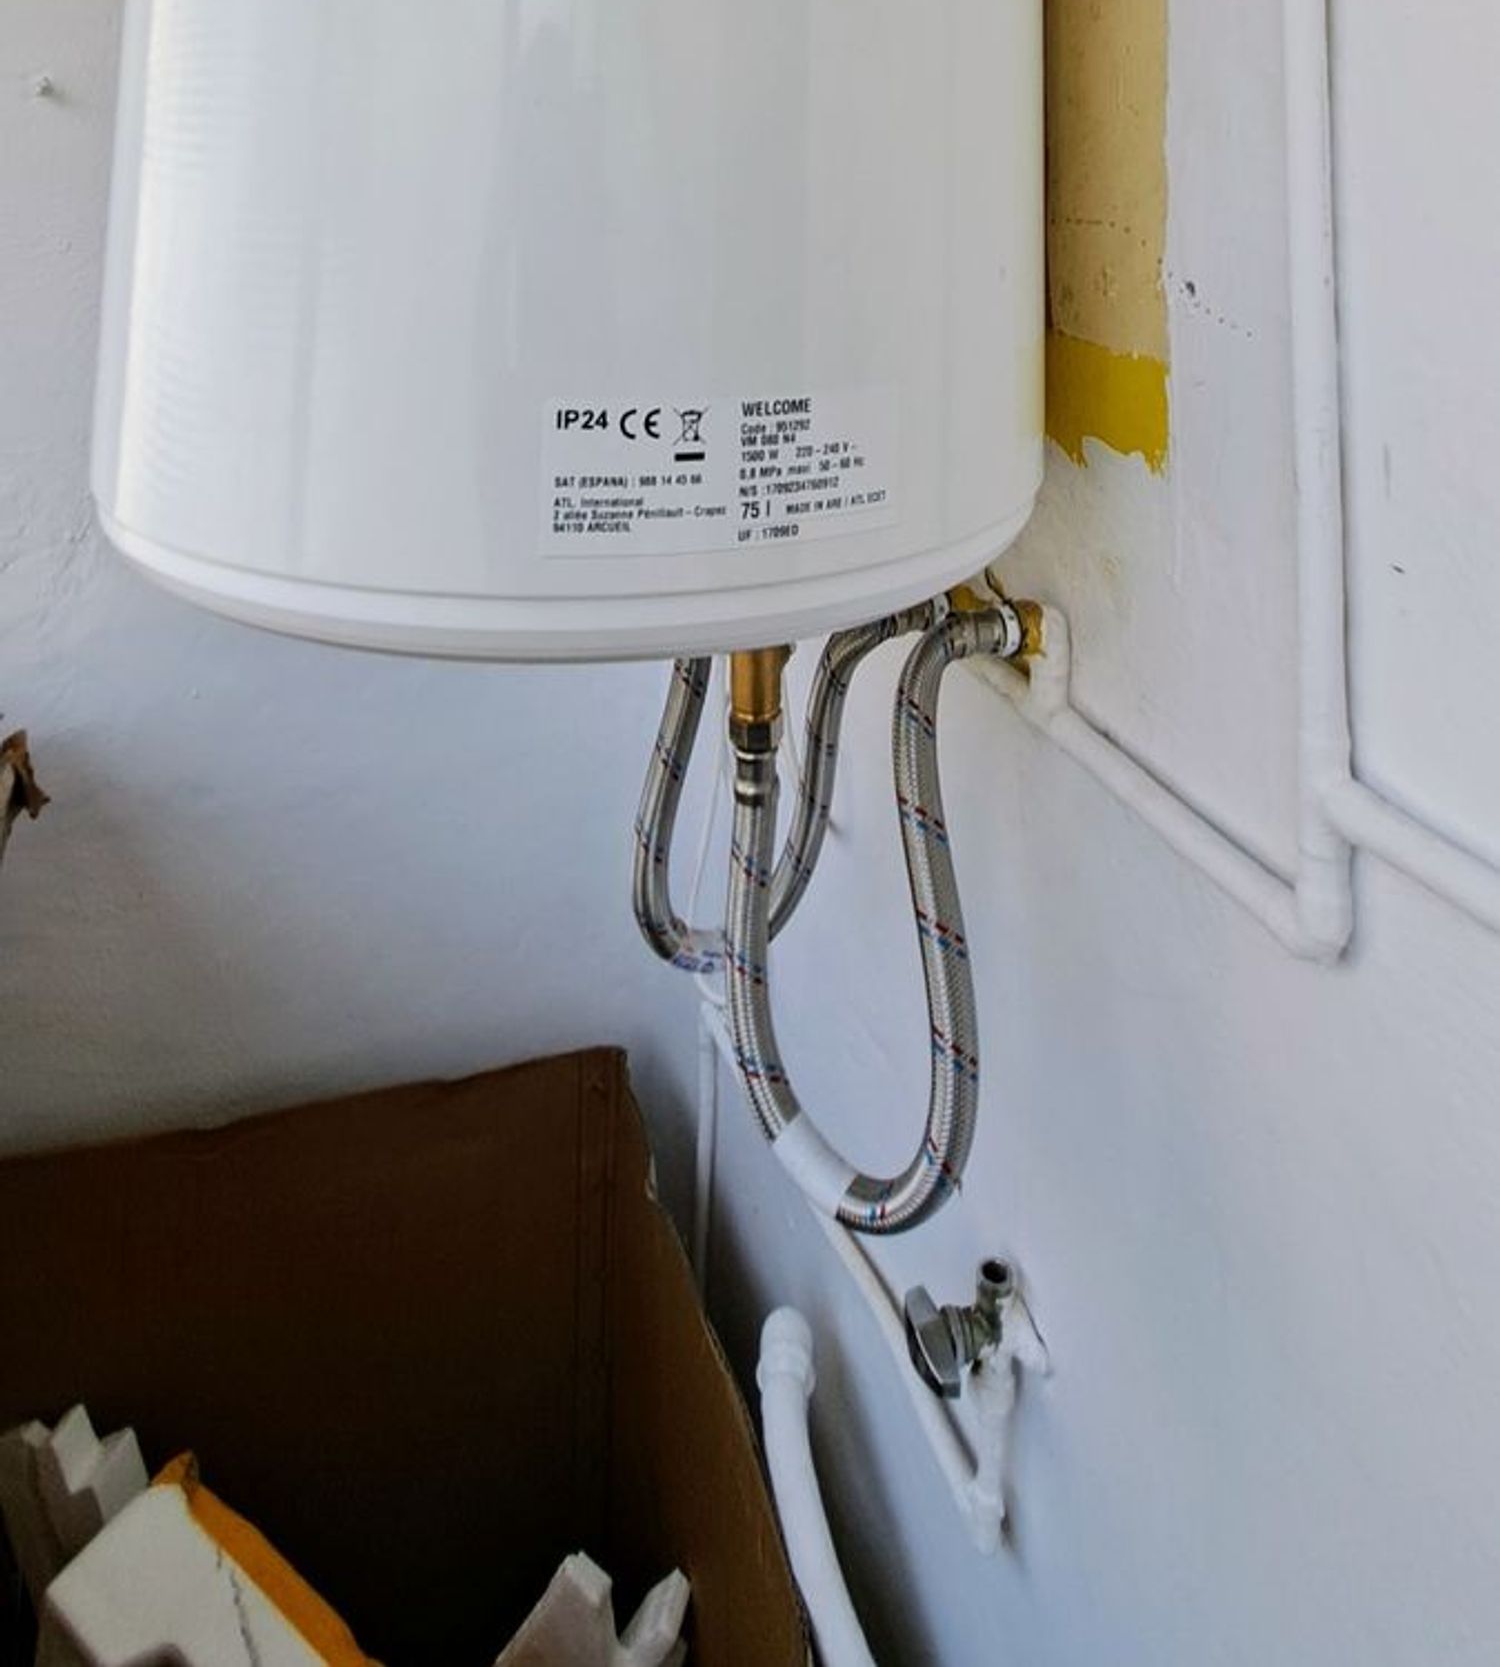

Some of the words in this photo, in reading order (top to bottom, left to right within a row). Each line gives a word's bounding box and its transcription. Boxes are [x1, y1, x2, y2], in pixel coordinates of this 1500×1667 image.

[742, 397, 811, 416] WELCOME
[557, 409, 608, 430] IP24
[740, 435, 757, 446] VM
[741, 449, 765, 462] 1500
[769, 449, 778, 460] W
[795, 445, 813, 458] 220
[823, 442, 839, 455] 240
[842, 441, 850, 453] V
[555, 476, 575, 488] SAT
[661, 475, 672, 486] 14
[580, 497, 643, 508] International
[554, 510, 559, 520] 2
[591, 510, 633, 520] Suzanne
[741, 501, 760, 519] 75
[786, 502, 811, 514] MADE
[814, 500, 823, 511] IN
[586, 521, 630, 533] ARCUEIL
[738, 529, 751, 542] UF
